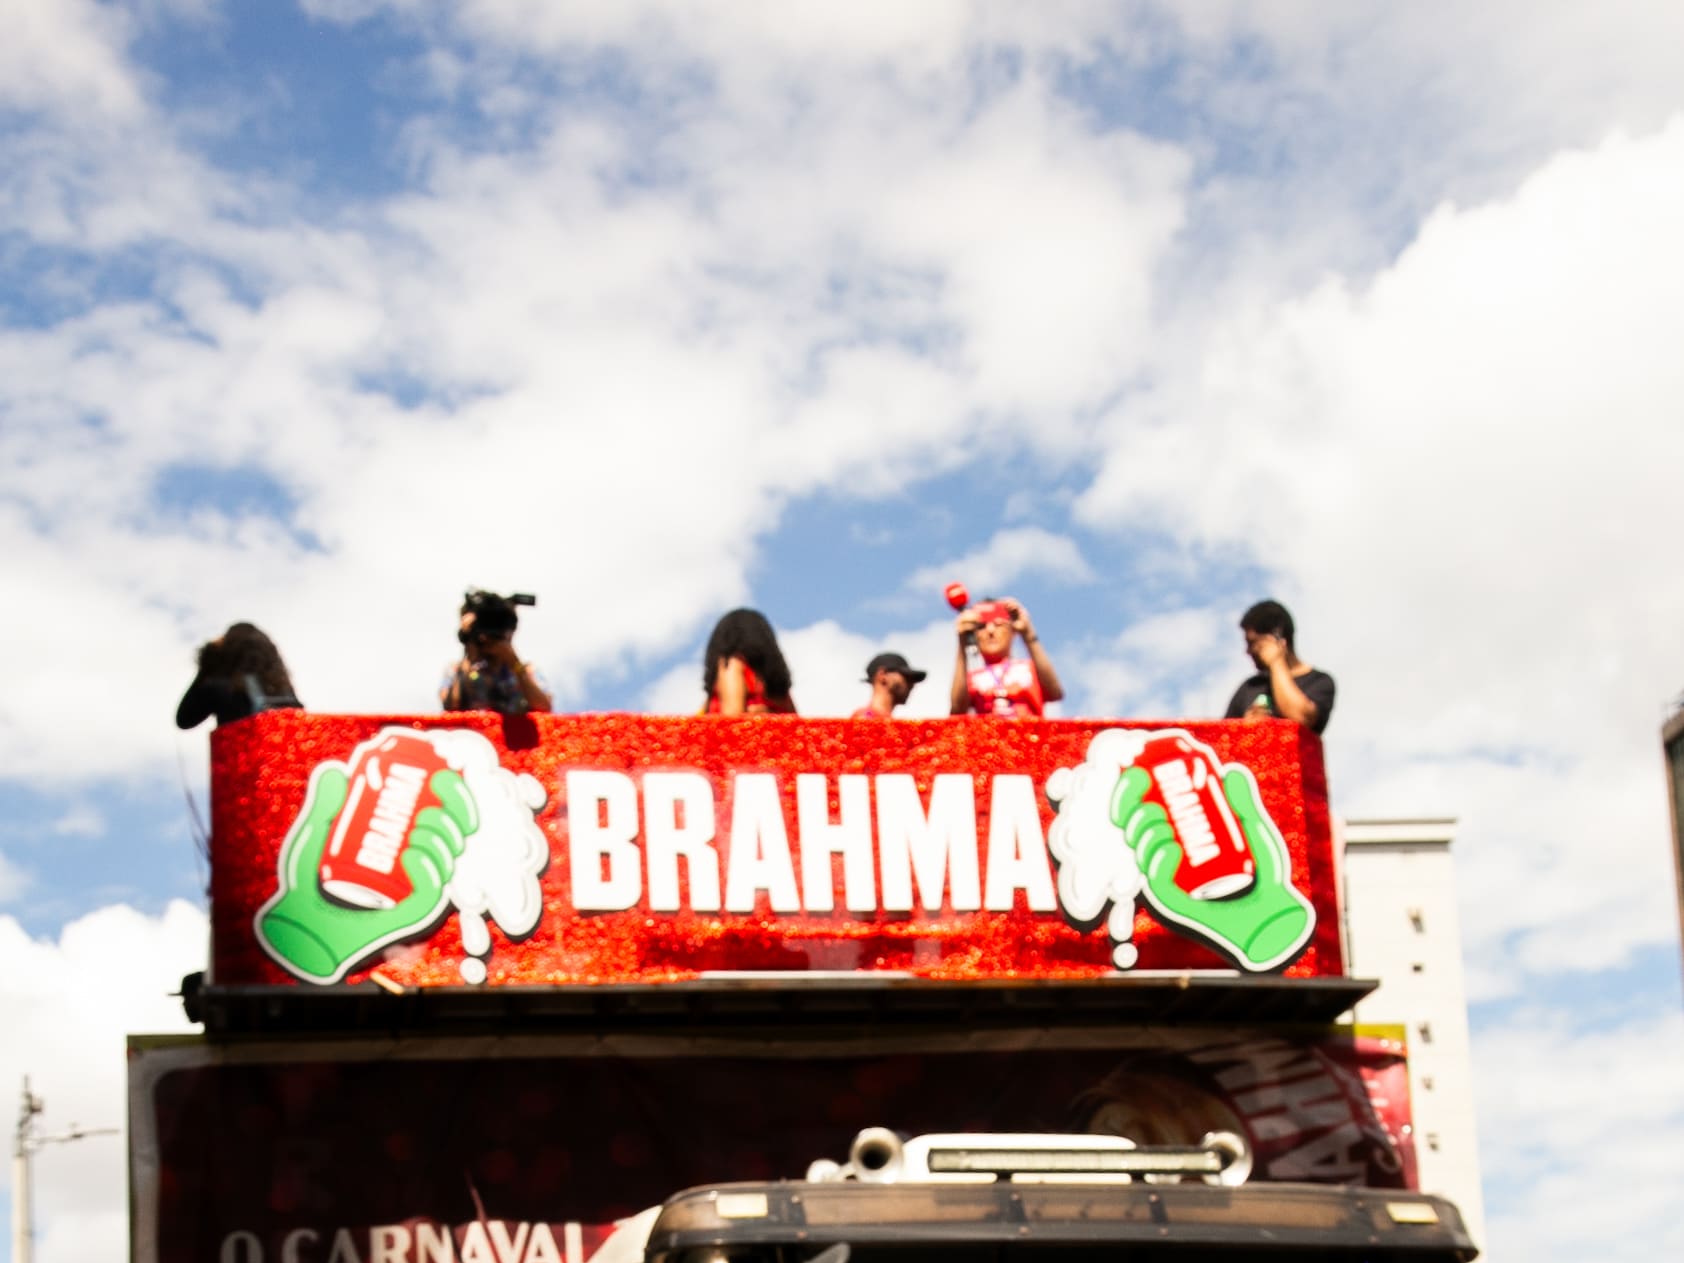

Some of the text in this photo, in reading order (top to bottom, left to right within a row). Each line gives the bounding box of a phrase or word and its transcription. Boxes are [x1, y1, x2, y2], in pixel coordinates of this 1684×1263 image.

[355, 762, 427, 874] BRAHMA
[566, 769, 1057, 914] BRAHMA
[1153, 758, 1222, 868] BRAHMA
